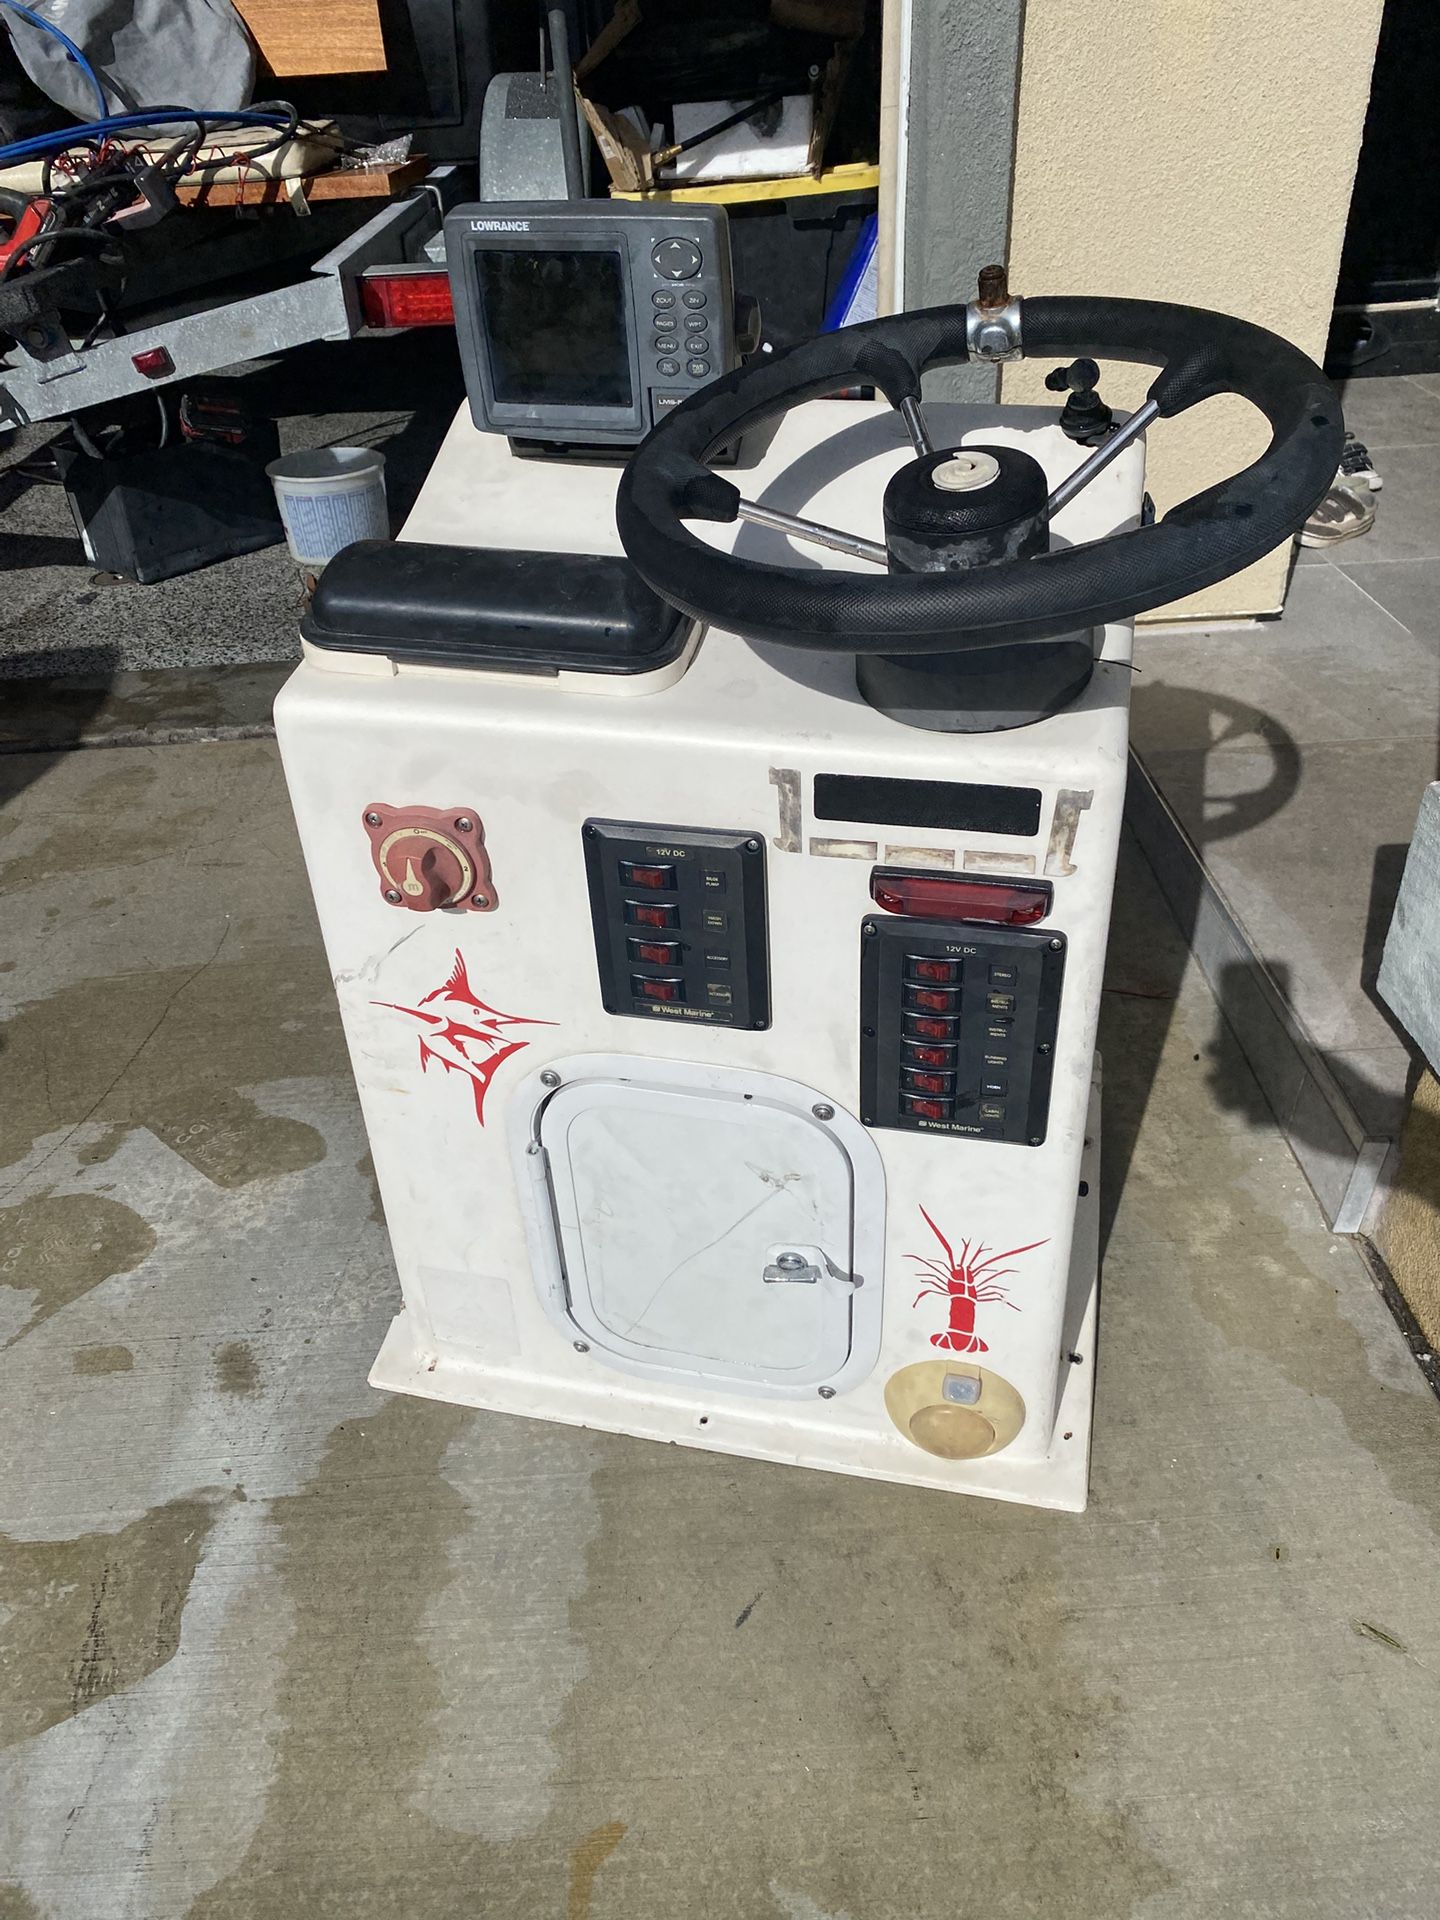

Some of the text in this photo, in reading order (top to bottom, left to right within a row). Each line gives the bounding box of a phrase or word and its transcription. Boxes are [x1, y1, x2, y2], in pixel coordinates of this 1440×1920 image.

[470, 220, 531, 231] LOWRANCE
[655, 848, 686, 858] 12V DC
[946, 945, 962, 953] 12V
[661, 1005, 713, 1018] West Marine
[928, 1121, 982, 1133] West Marine
